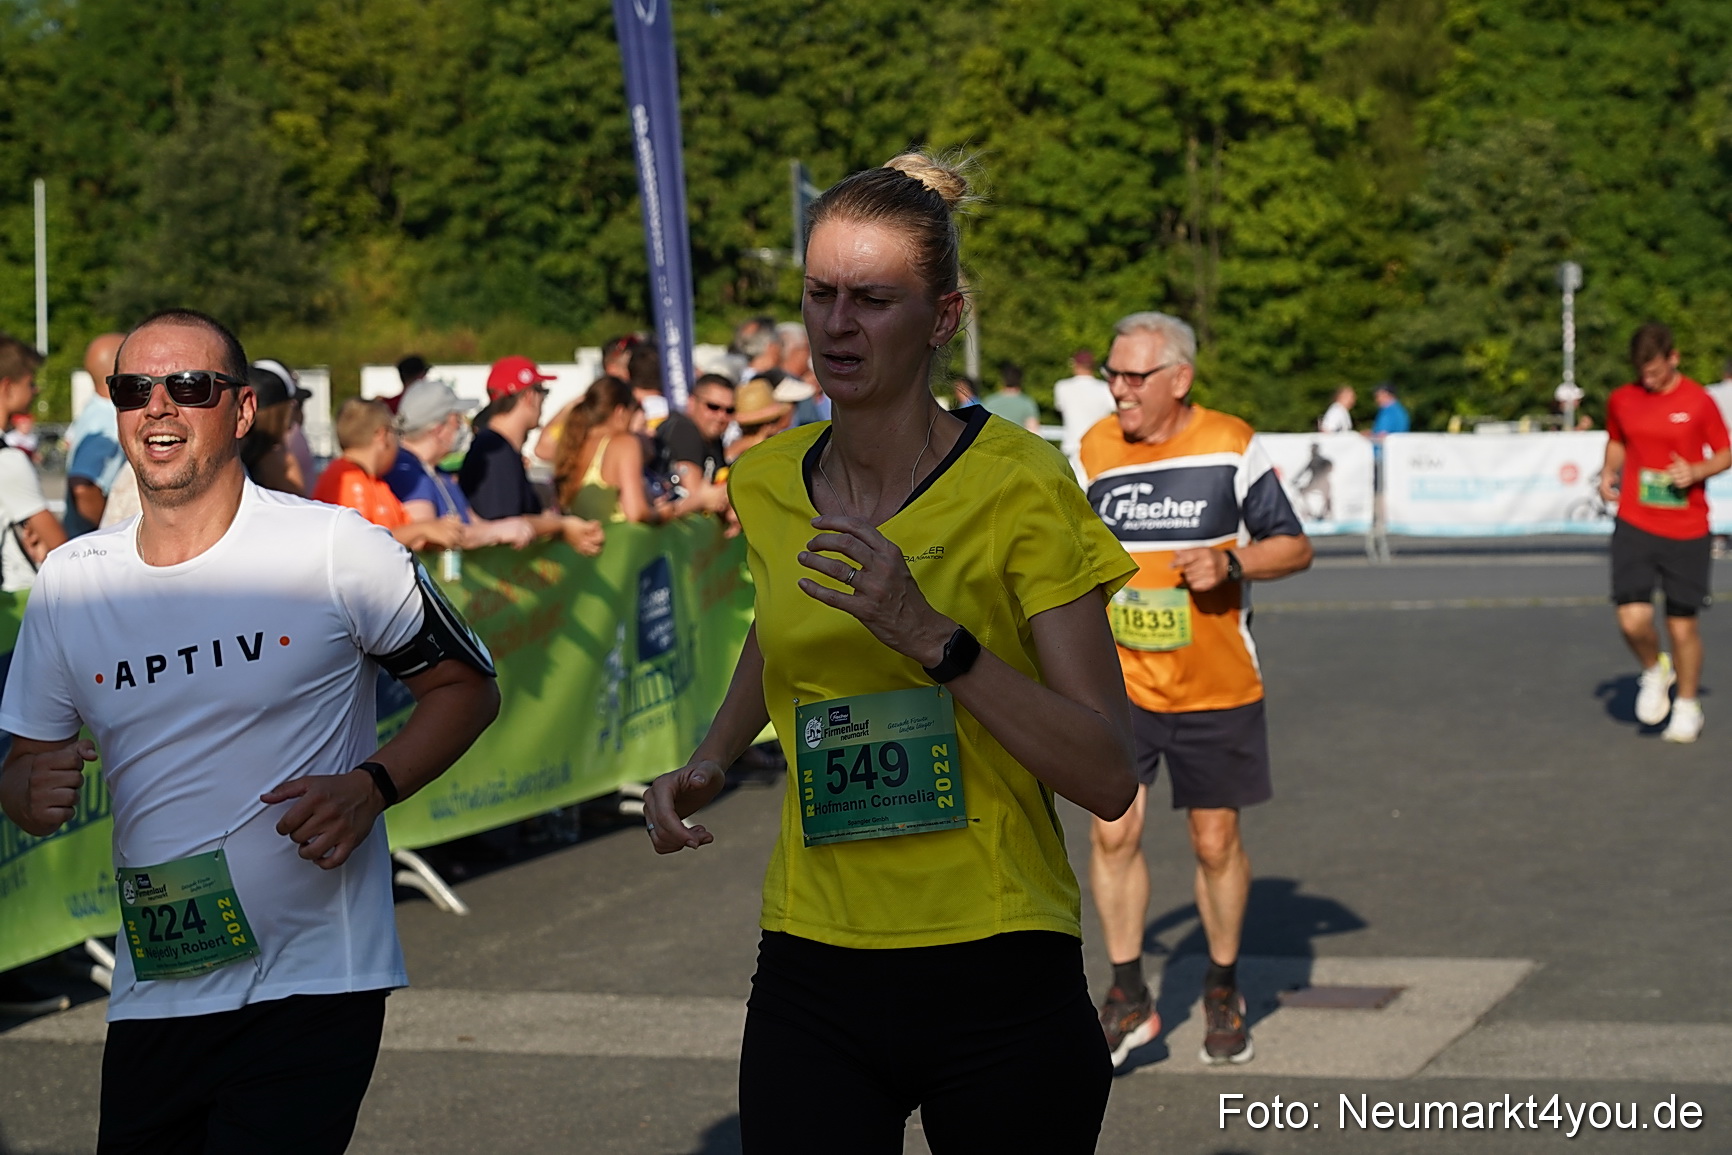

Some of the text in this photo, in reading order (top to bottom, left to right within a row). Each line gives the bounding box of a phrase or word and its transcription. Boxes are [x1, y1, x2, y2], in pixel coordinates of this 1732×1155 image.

[1114, 496, 1208, 521] Fischer
[1122, 516, 1201, 531] AUTOMOBILE
[82, 548, 107, 558] JAKO
[1120, 608, 1177, 630] 1833
[115, 631, 264, 690] APTIV
[823, 719, 870, 739] Firmenlauf
[840, 729, 870, 741] neumarkt
[826, 741, 909, 795] 549
[931, 743, 954, 809] 2022
[803, 769, 815, 817] RUN
[814, 789, 936, 816] Hofmann Cornelia
[141, 898, 207, 942] 224
[217, 896, 246, 946] 2022
[127, 920, 145, 958] RUN
[181, 934, 228, 955] Robert
